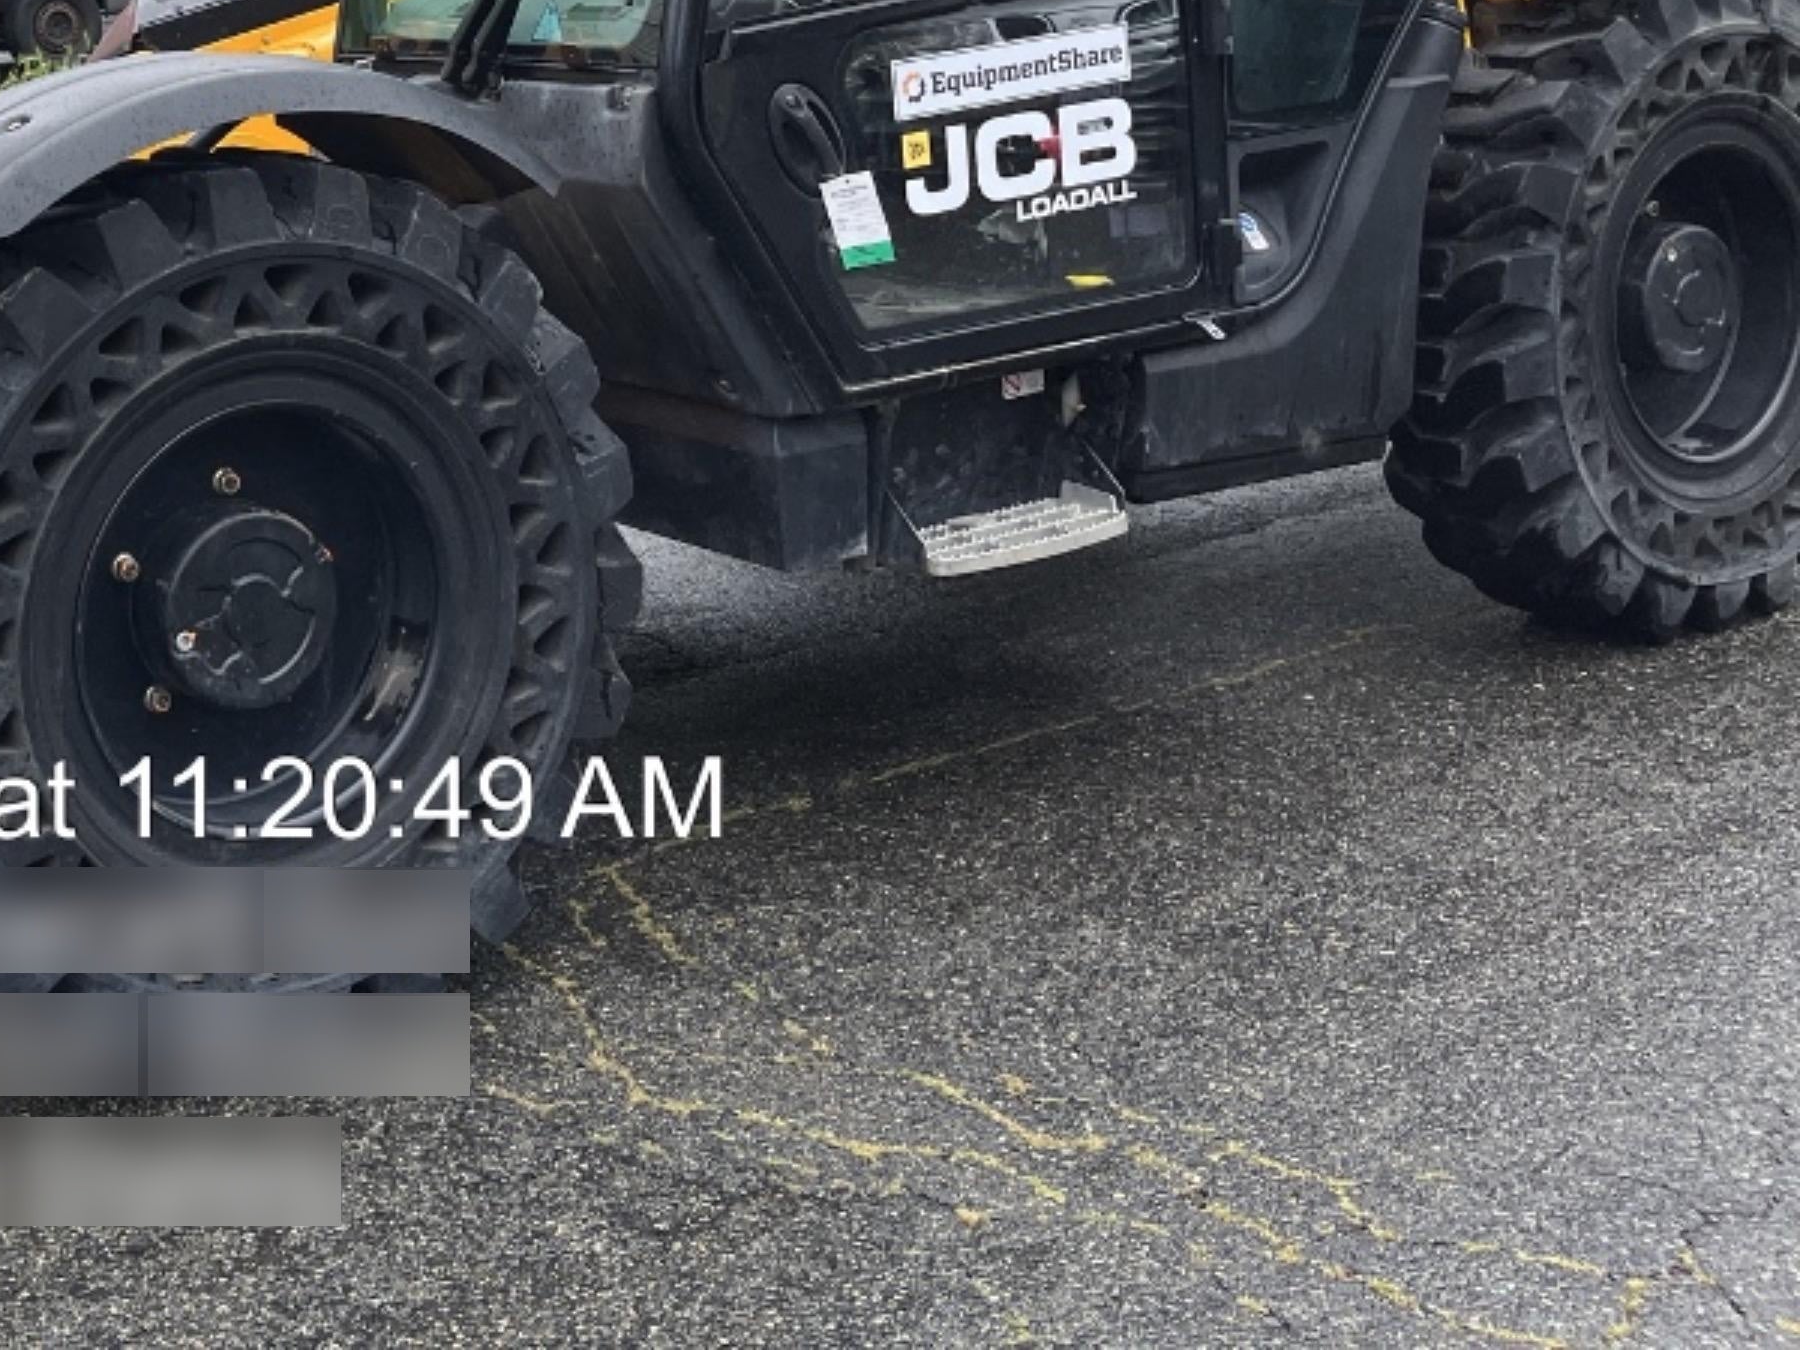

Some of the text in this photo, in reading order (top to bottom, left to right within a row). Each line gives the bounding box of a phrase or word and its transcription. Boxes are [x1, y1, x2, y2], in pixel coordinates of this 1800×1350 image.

[931, 44, 1124, 98] EquipmentShare
[904, 97, 1138, 216] JCB
[1016, 180, 1138, 223] LOADALL
